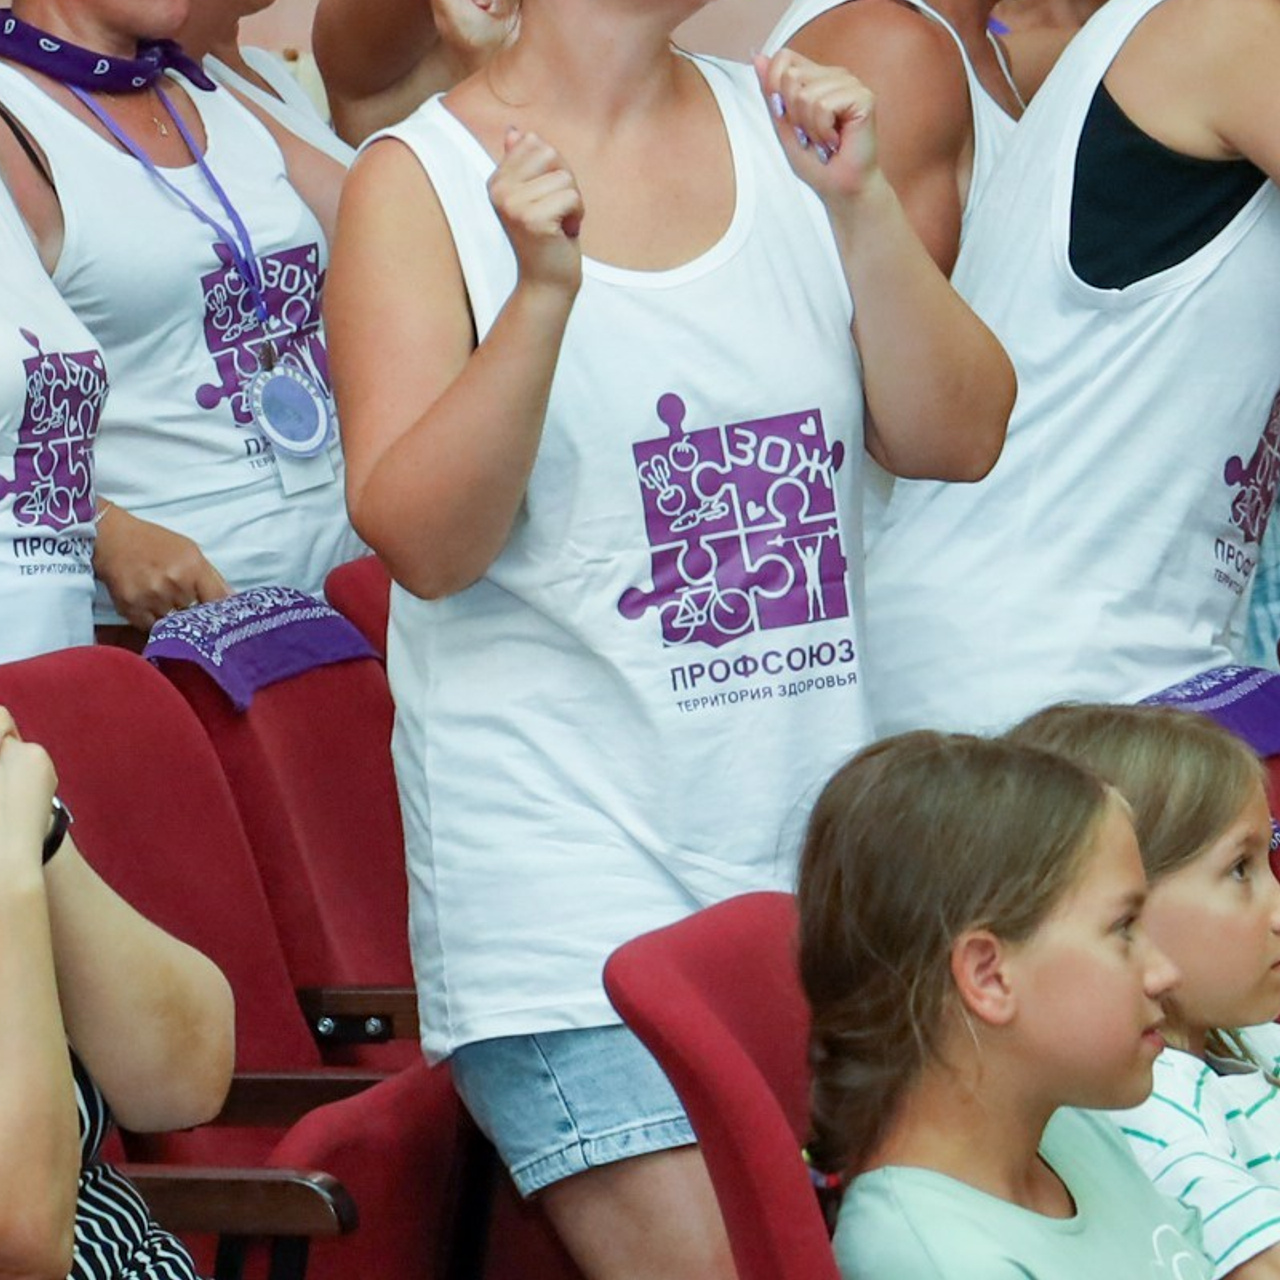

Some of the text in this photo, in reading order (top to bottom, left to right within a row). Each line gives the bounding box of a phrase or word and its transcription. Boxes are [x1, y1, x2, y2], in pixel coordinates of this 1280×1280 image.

[729, 427, 833, 489] ЗОЖ
[671, 638, 855, 692] ПРОФСОЮЗ
[677, 671, 858, 714] ТЕРРИТОРИЯ ЗДОРОВЬЯ
